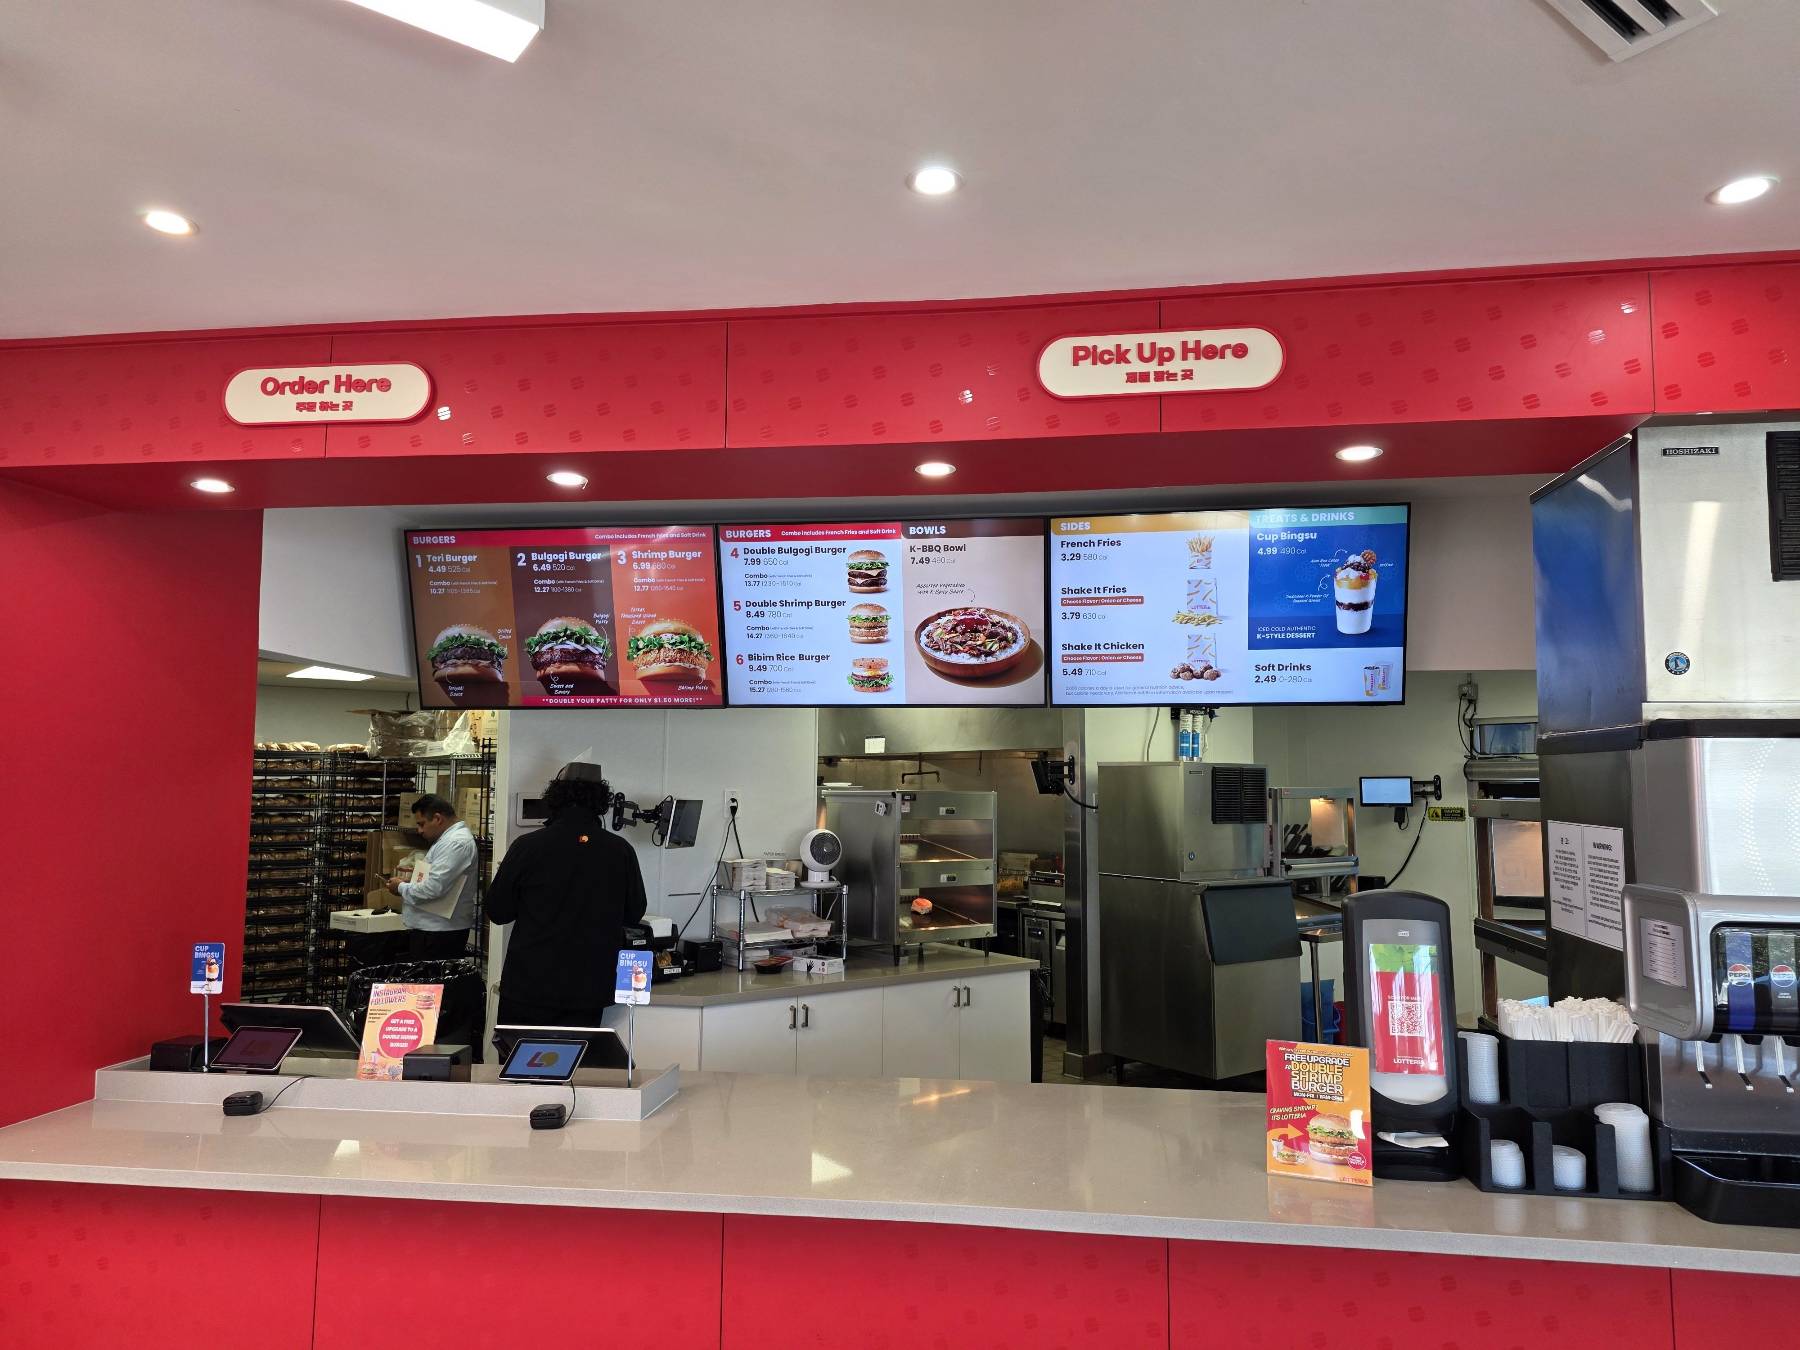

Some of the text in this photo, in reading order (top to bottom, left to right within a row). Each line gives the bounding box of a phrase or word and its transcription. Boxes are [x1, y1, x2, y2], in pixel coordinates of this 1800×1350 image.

[1072, 340, 1248, 366] Pick Up Here
[260, 374, 391, 396] Order Here
[1666, 447, 1716, 455] HOSHIZAKI
[1312, 512, 1354, 521] DRINKS
[909, 526, 946, 535] BOWLS
[1060, 522, 1090, 531] SIDES
[726, 530, 771, 538] BURGERS
[1257, 531, 1317, 543] Cup Bingsu
[413, 536, 456, 544] BURGERS
[1061, 538, 1121, 548] French Fries
[730, 548, 739, 558] 4
[744, 546, 846, 556] Double Bulgogi Burger
[910, 544, 966, 553] K-BBQ Bowl
[426, 554, 477, 564] Teri Burger
[517, 553, 526, 566] 2
[532, 551, 601, 562] Bulgogi Burger
[618, 551, 626, 565] 3
[632, 550, 702, 560] Shrimp Burger
[416, 555, 422, 567] 1
[633, 562, 651, 570] 6.99
[744, 558, 761, 566] 7.99
[1062, 587, 1092, 595] Shake
[1103, 586, 1127, 594] Fries
[734, 601, 741, 611] 5
[746, 599, 846, 609] Double Shrimp Burger
[1062, 612, 1081, 620] 3.79
[1062, 643, 1092, 651] Shake
[1103, 642, 1145, 650] Chicken
[736, 654, 744, 665] 6
[748, 653, 830, 663] Bibim Rice Burger
[1278, 662, 1312, 671] Drinks
[1062, 668, 1083, 676] 5.49
[1255, 675, 1277, 683] 2.49
[620, 952, 636, 960] CUP
[1285, 1054, 1350, 1066] FREE UPGRADE
[1291, 1061, 1343, 1075] DOUBLE
[1292, 1071, 1343, 1085] SHRIMP
[1292, 1080, 1343, 1094] BURGER
[1294, 1104, 1319, 1112] SHRIMP?
